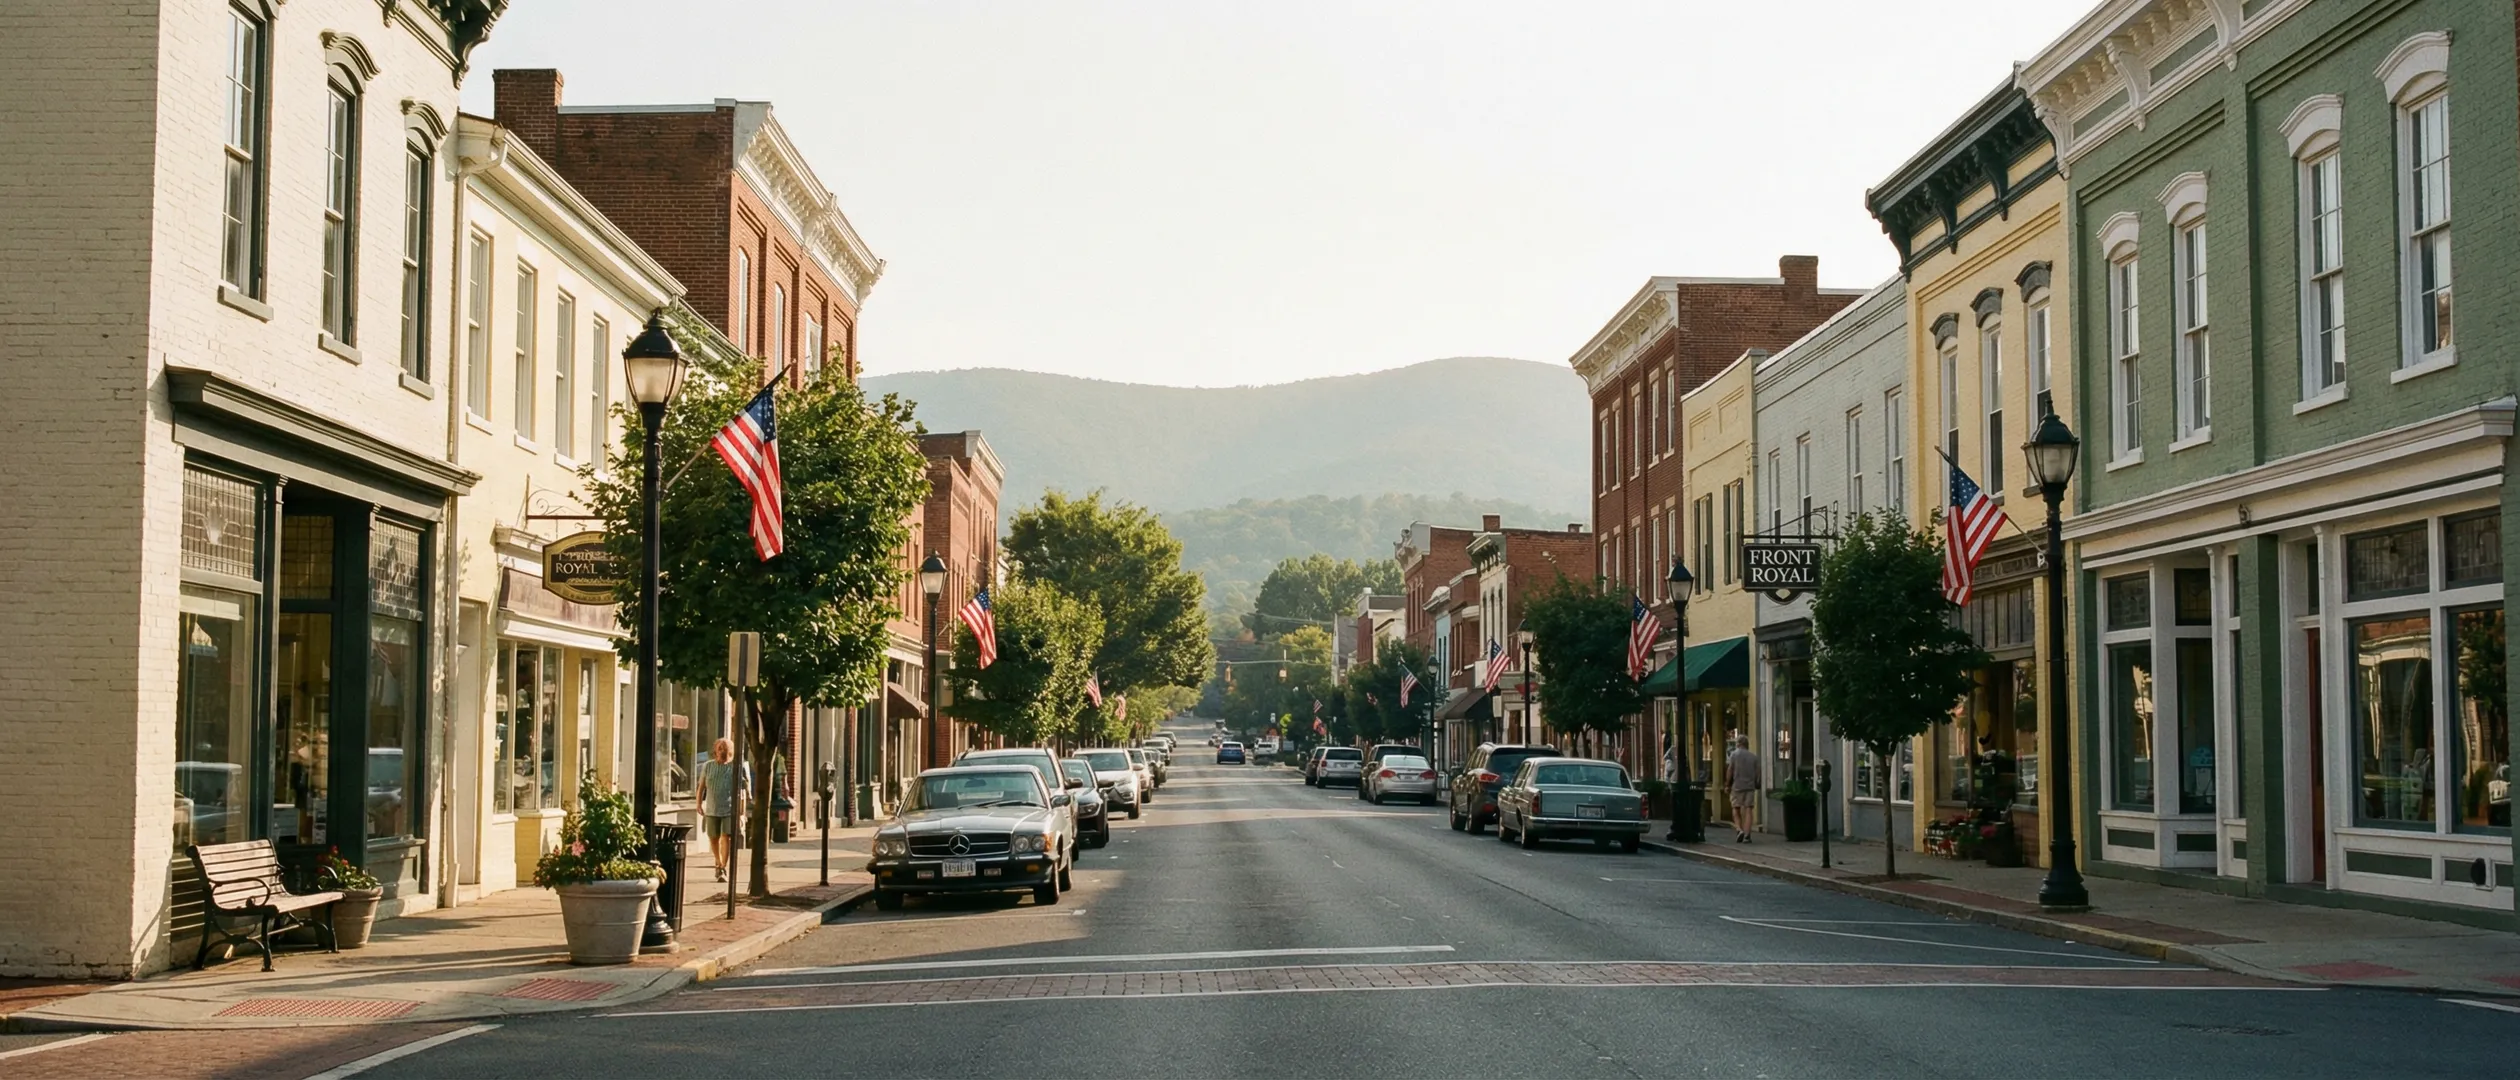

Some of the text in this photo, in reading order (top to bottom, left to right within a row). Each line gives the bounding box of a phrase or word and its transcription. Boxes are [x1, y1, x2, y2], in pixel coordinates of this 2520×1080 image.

[1749, 549, 1816, 565] FRONT
[555, 562, 598, 575] ROYAL
[1751, 567, 1815, 583] ROYAL
